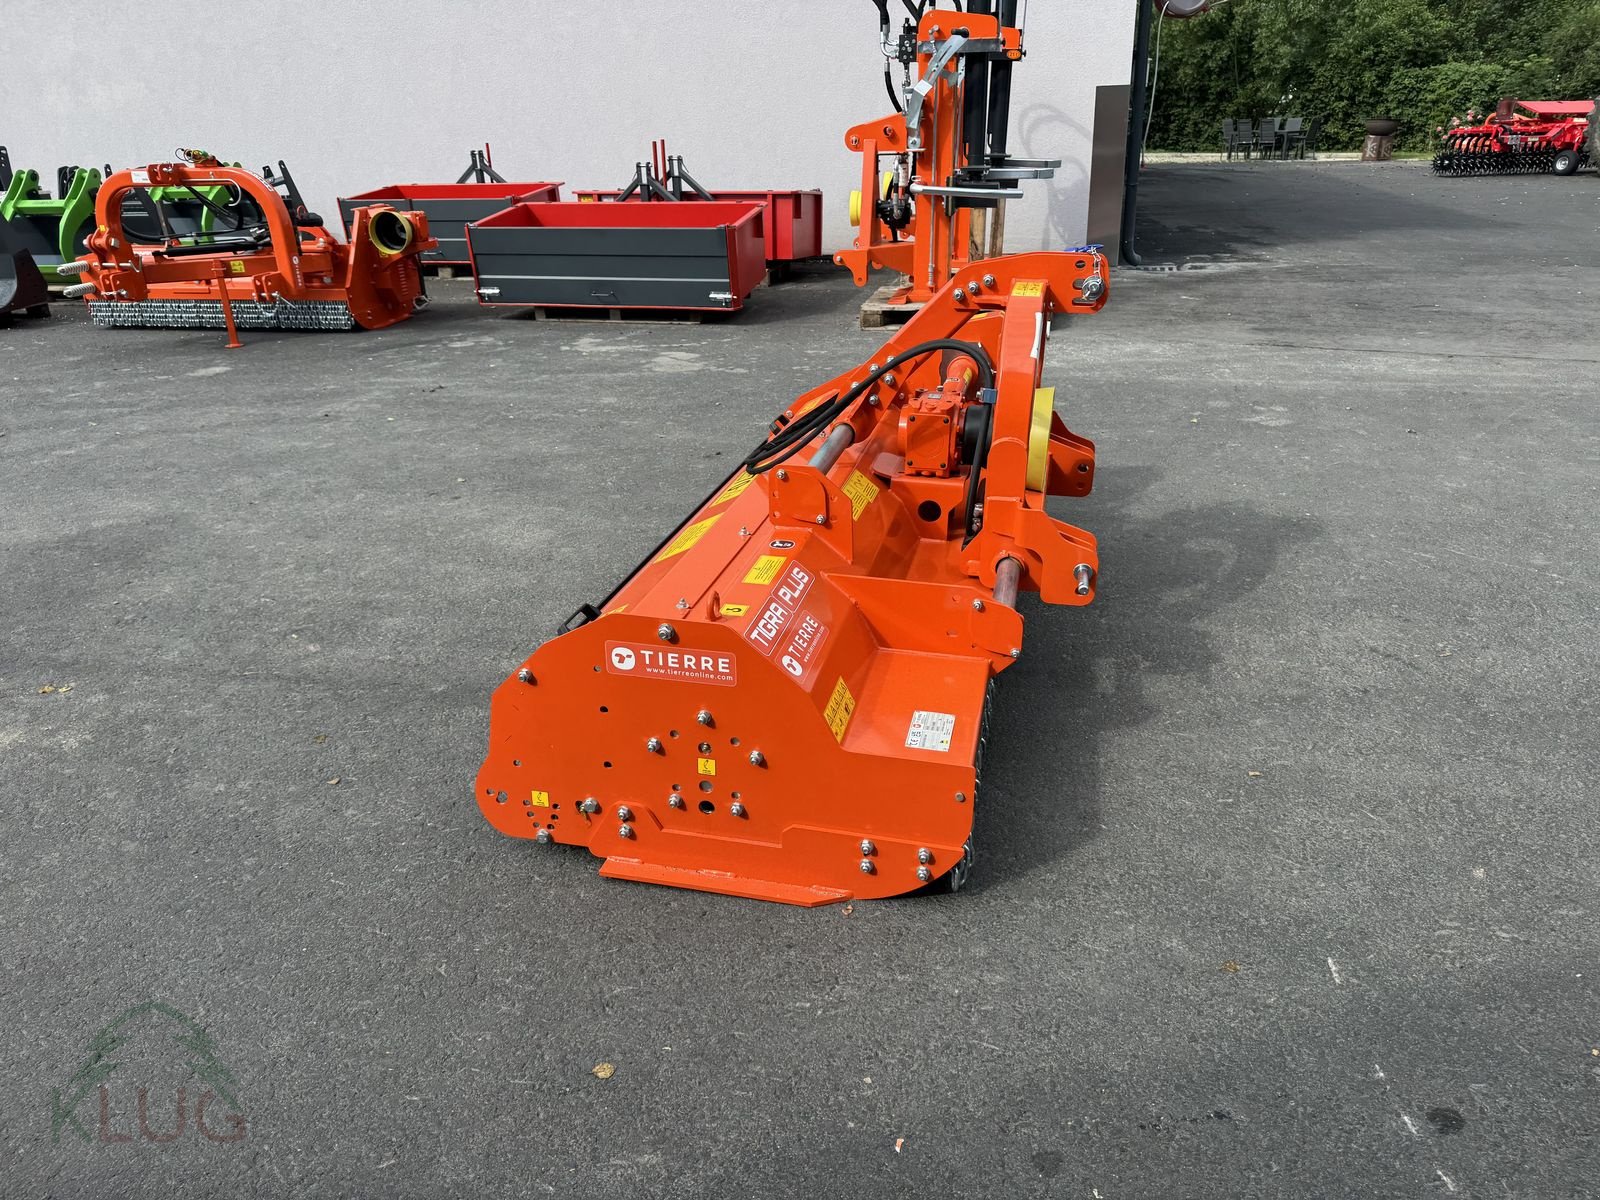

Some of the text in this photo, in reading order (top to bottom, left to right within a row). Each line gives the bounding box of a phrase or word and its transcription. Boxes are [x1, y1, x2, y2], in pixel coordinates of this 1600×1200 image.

[750, 602, 788, 647] TIGRA
[778, 566, 810, 606] PLUS
[788, 615, 819, 658] TIERRE
[640, 650, 730, 673] TIERRE
[646, 667, 733, 681] www.tierreonline.com
